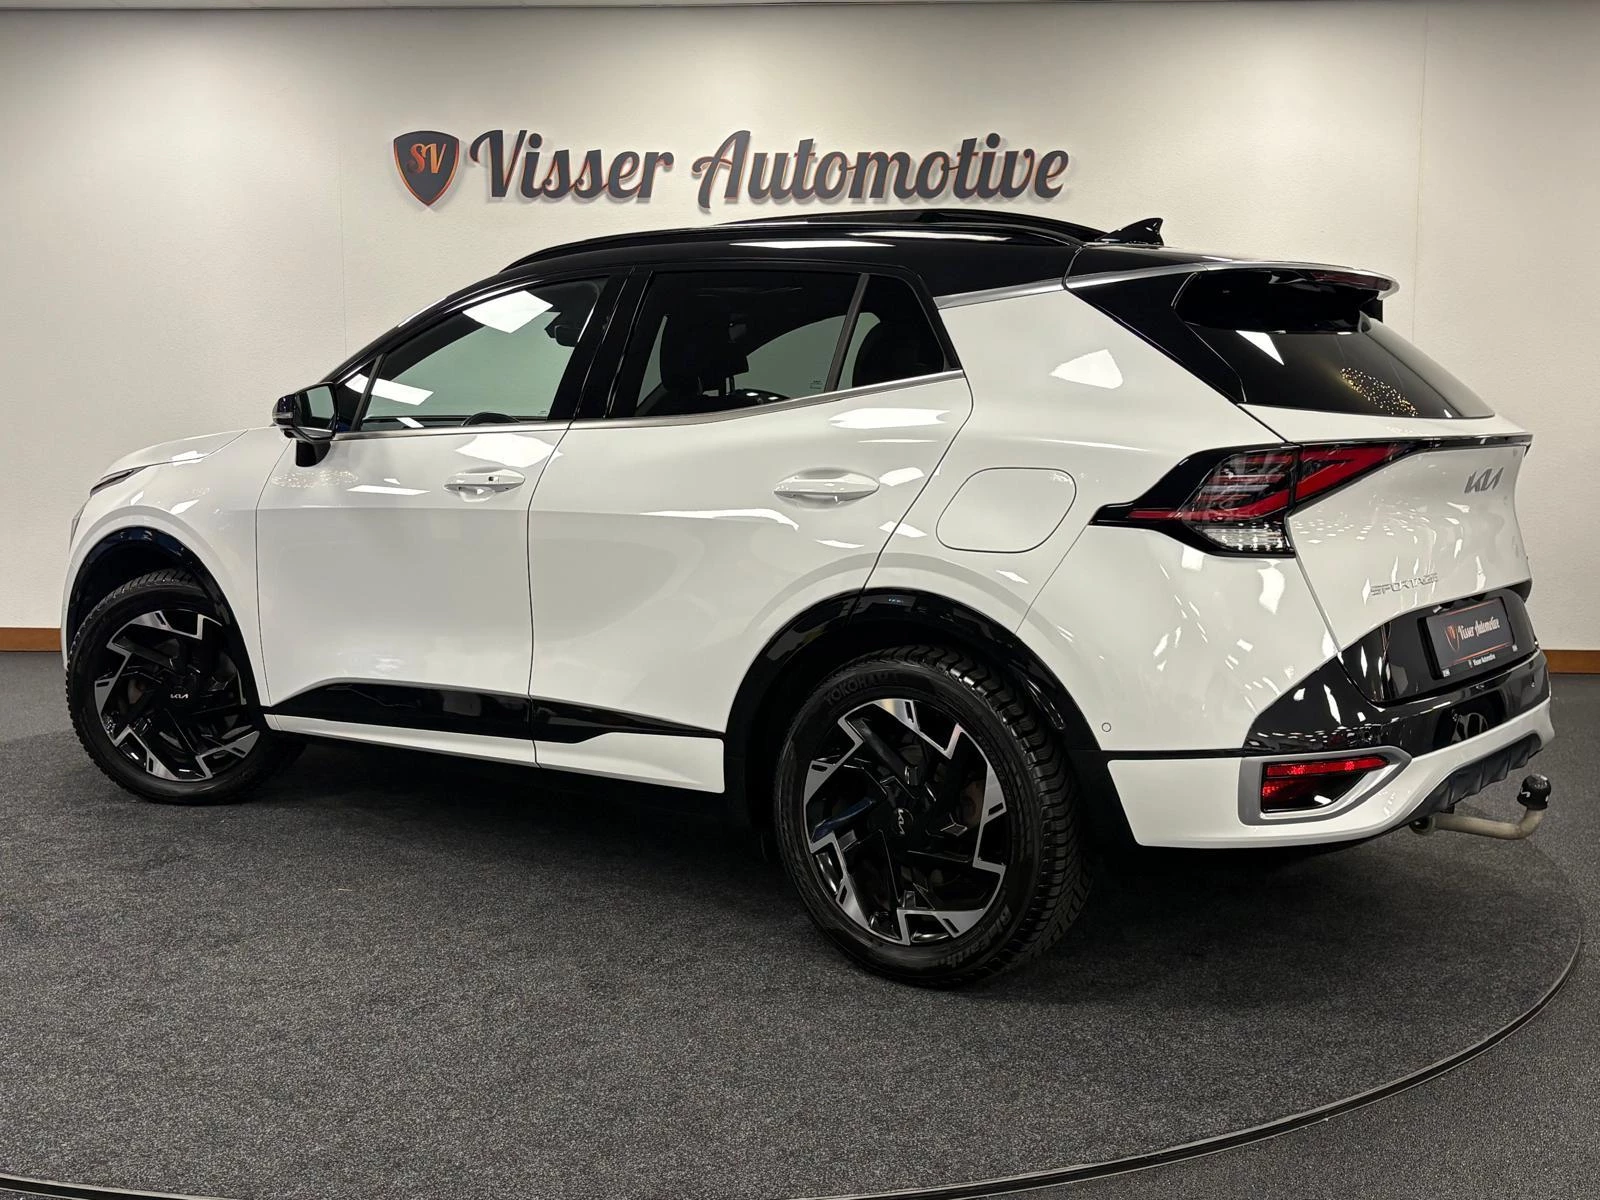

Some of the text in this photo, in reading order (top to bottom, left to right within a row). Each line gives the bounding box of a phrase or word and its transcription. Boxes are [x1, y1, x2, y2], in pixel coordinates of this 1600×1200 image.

[406, 143, 447, 175] SV
[469, 129, 1070, 210] Visser Automotive
[1464, 466, 1504, 494] KIA
[824, 671, 899, 705] YOKOHA
